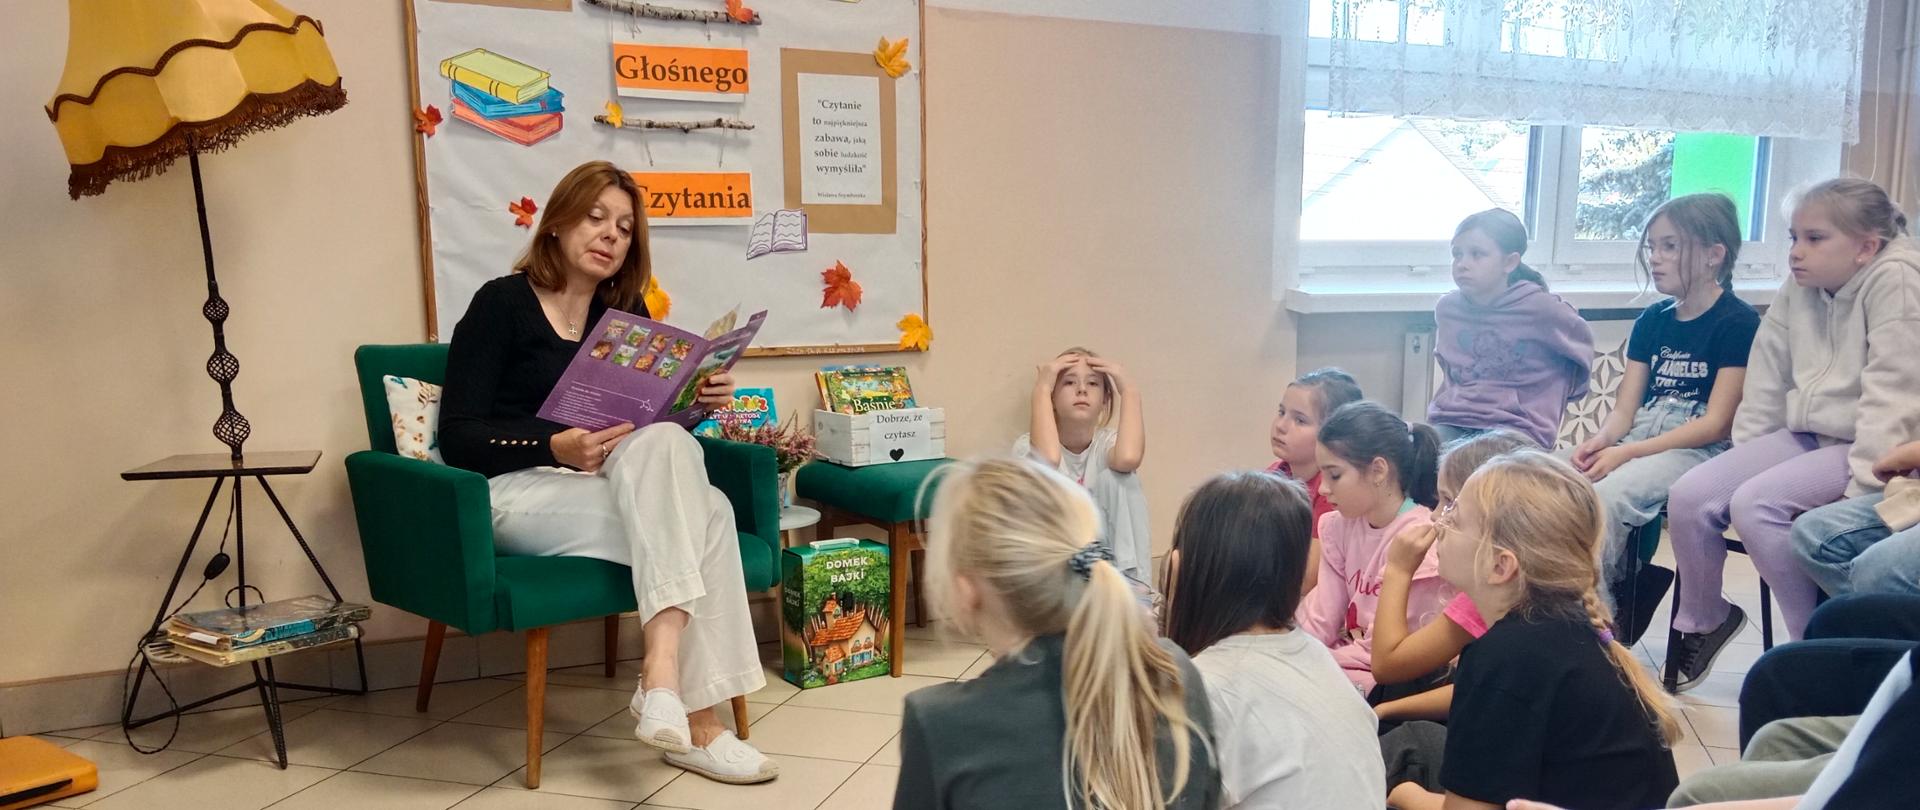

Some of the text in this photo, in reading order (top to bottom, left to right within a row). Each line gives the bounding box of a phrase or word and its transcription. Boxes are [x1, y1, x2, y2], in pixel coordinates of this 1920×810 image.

[615, 54, 748, 92] Głośnego
[818, 99, 862, 112] "Czytanie
[812, 117, 822, 126] to
[814, 133, 851, 145] zabawa,
[814, 148, 839, 158] sobie
[853, 397, 897, 412] Baśnie
[884, 430, 916, 442] czytasz
[826, 557, 868, 570] DOMEK
[830, 568, 865, 583] BAJKI
